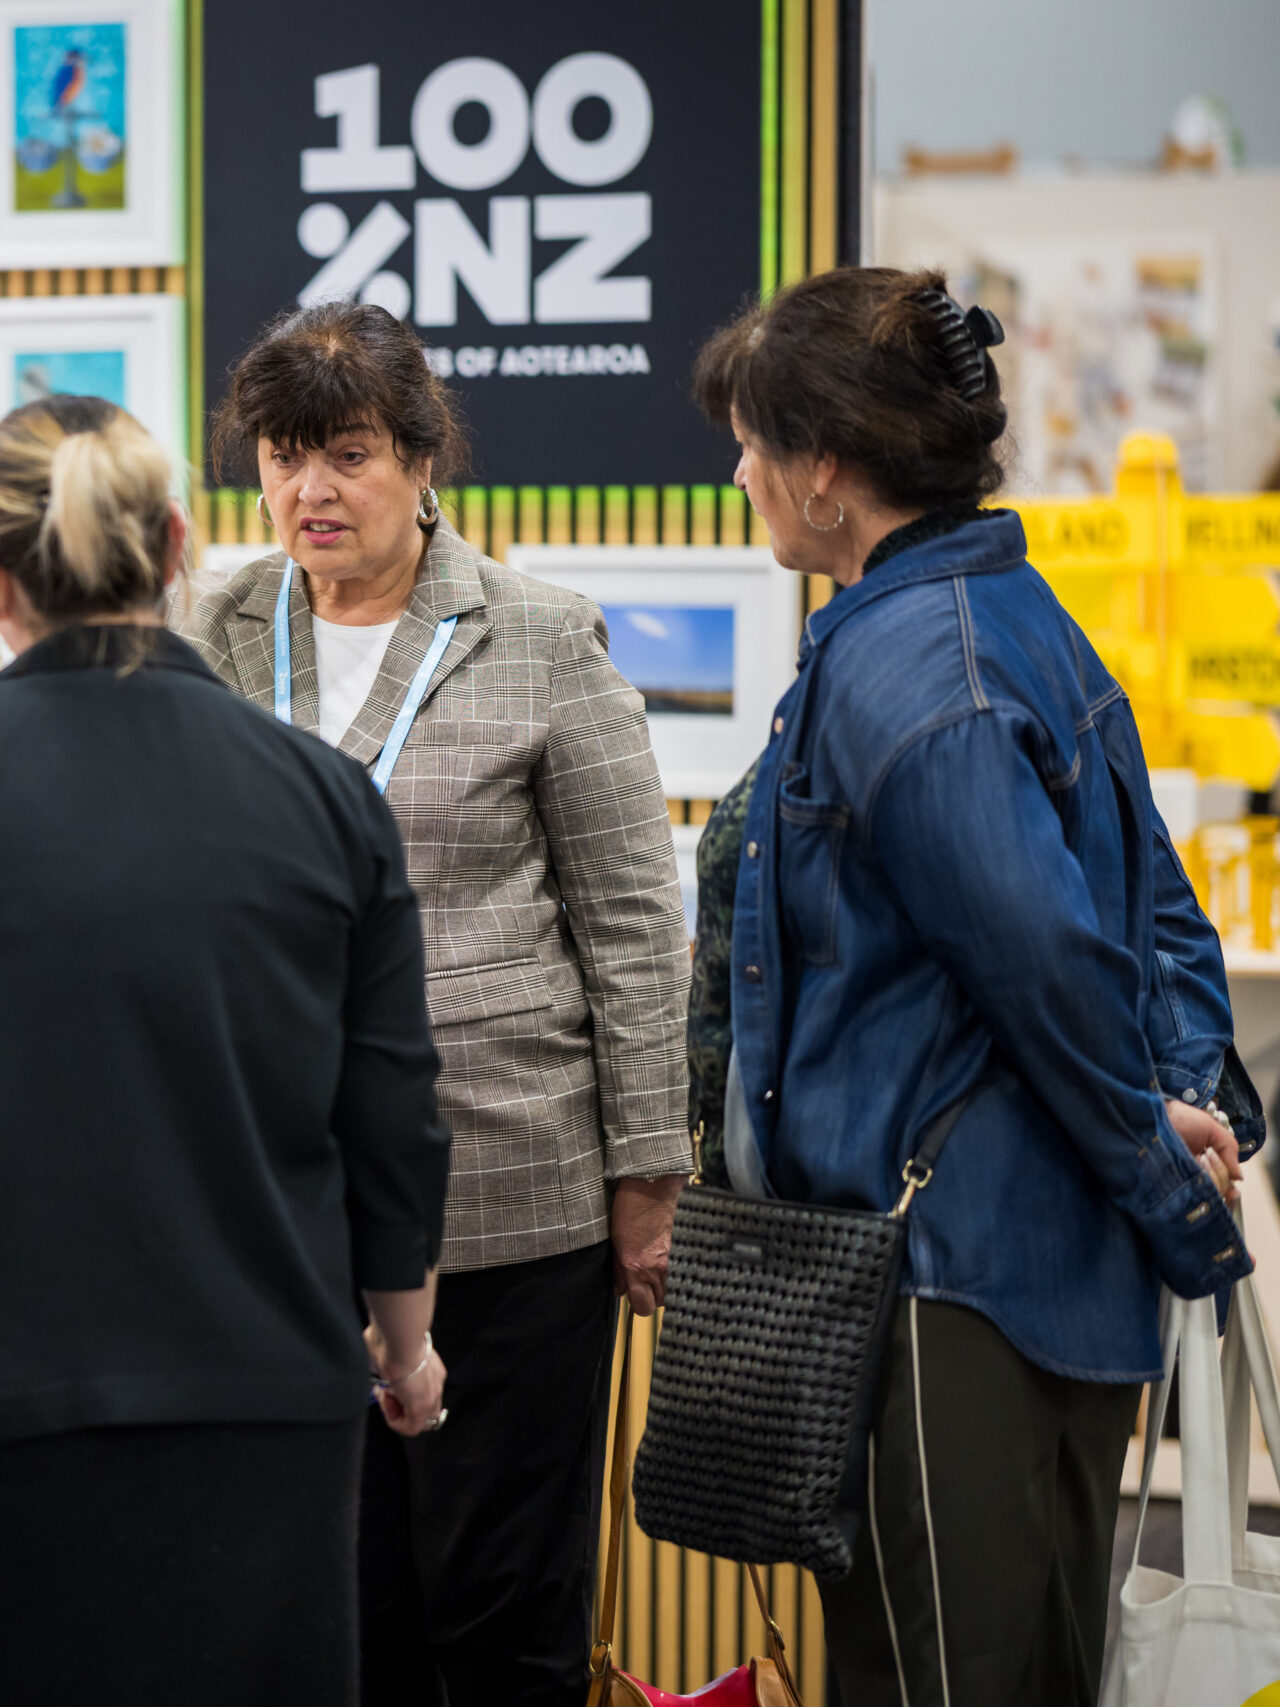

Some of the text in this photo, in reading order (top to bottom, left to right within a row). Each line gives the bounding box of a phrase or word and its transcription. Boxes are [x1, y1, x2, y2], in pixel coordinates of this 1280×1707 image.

[300, 51, 653, 193] 100
[297, 192, 652, 326] %NZ
[455, 346, 497, 378] OF
[499, 343, 652, 377] AOTEAROA
